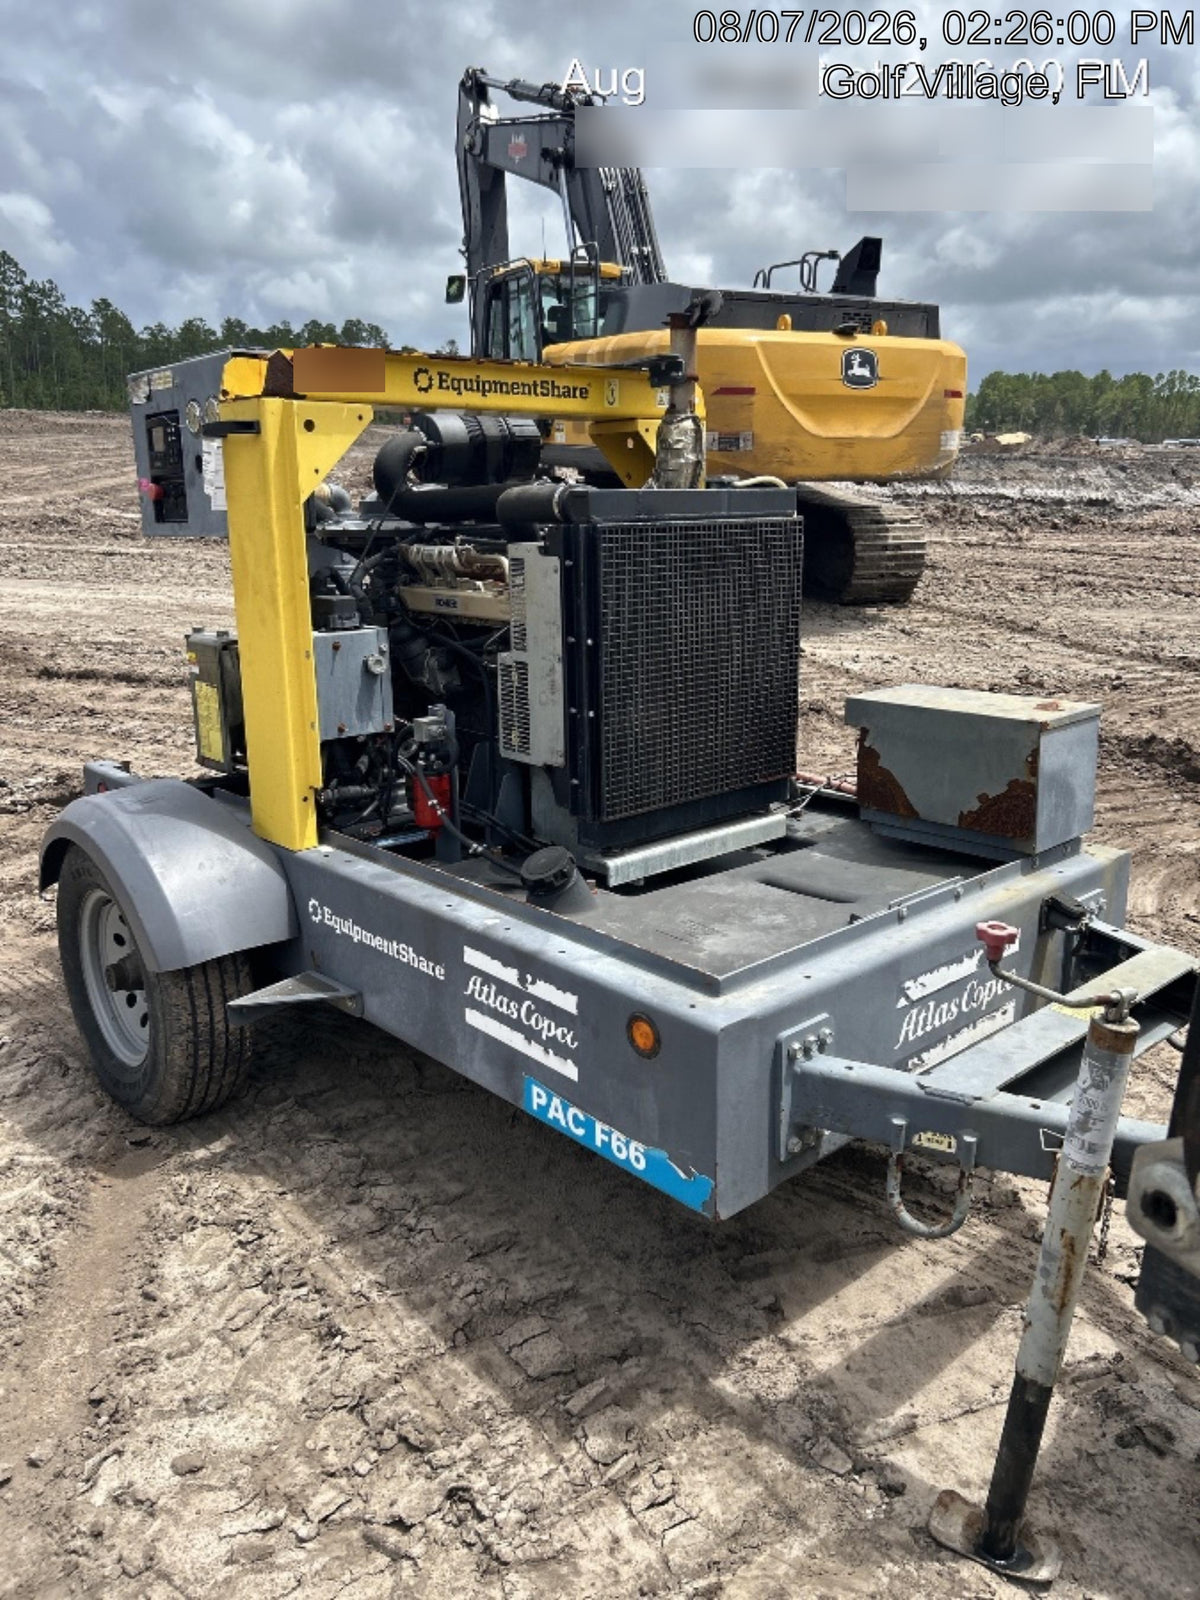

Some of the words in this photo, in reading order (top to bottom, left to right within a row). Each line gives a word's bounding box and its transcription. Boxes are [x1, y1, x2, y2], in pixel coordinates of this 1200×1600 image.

[437, 371, 589, 400] EquipmentShare
[322, 905, 446, 980] EquipmentShare
[464, 975, 519, 1020] Atlas
[894, 998, 960, 1050] Atlas
[531, 1083, 586, 1136] PAC
[595, 1119, 648, 1171] F66
